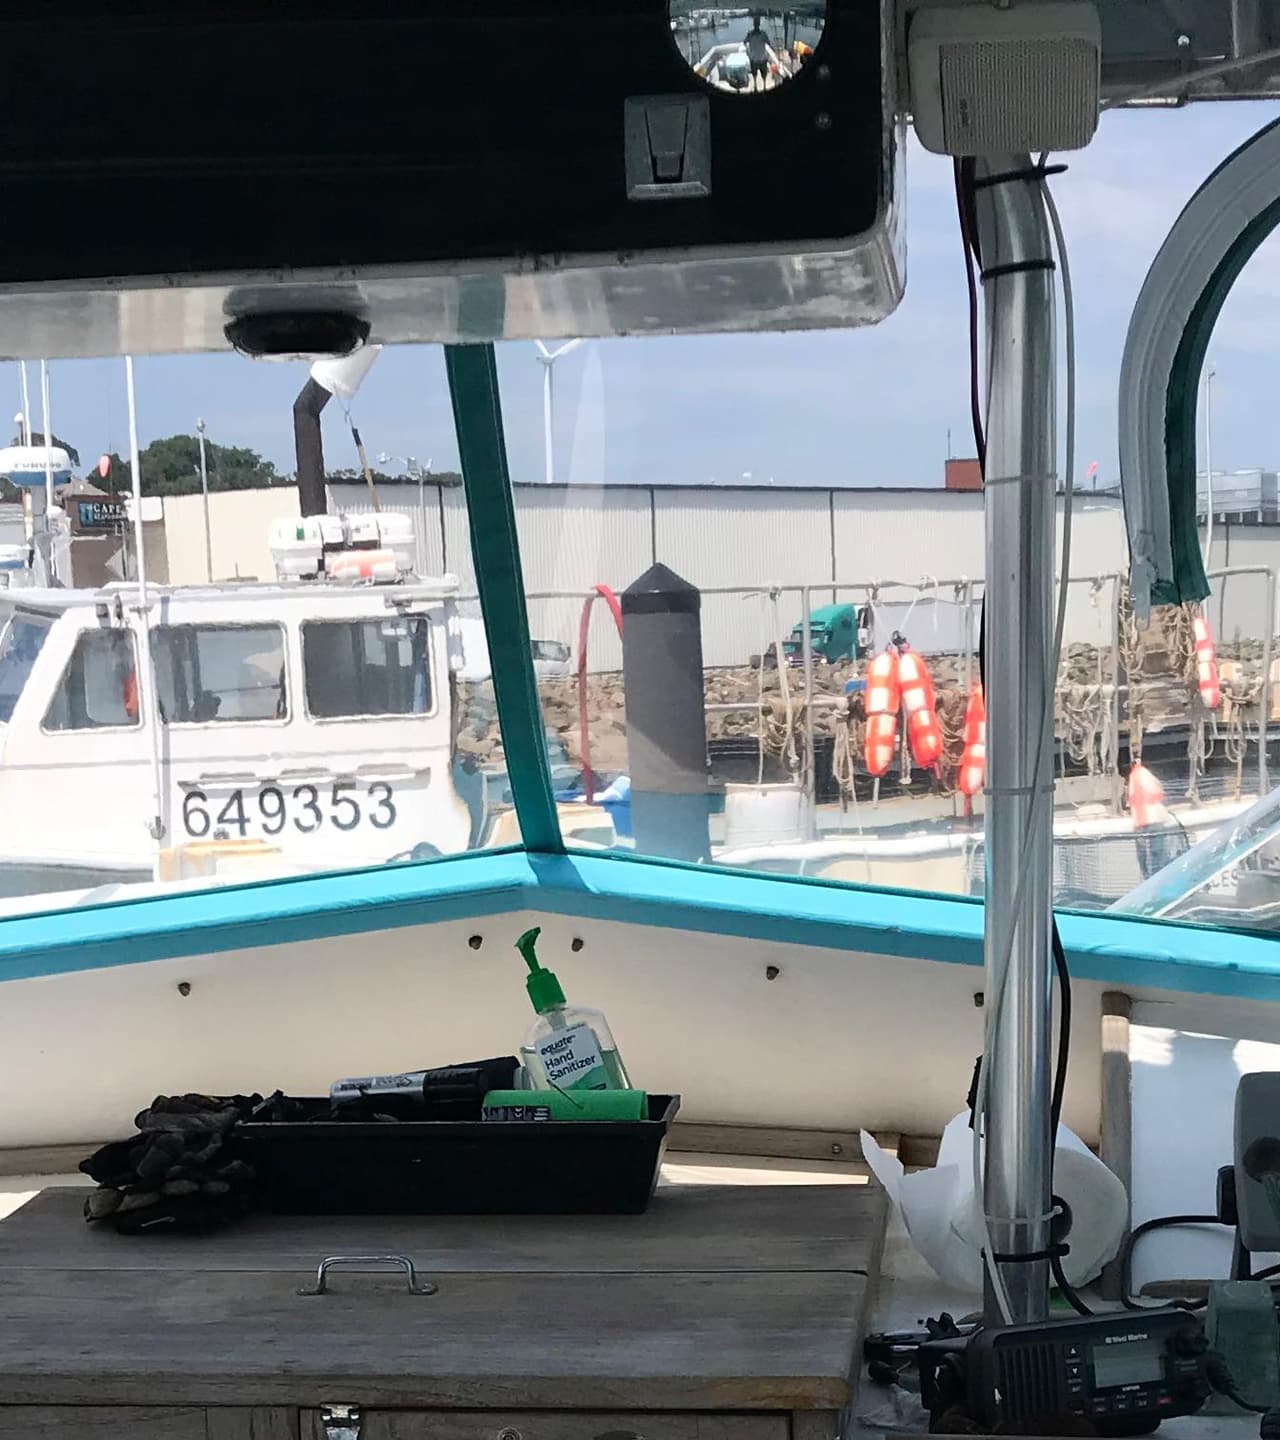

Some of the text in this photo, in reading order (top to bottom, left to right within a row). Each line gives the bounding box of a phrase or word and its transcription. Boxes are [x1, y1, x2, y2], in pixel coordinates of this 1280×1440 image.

[182, 780, 397, 838] 649353
[544, 1049, 574, 1070] Hand
[549, 1055, 596, 1081] Sanitizer
